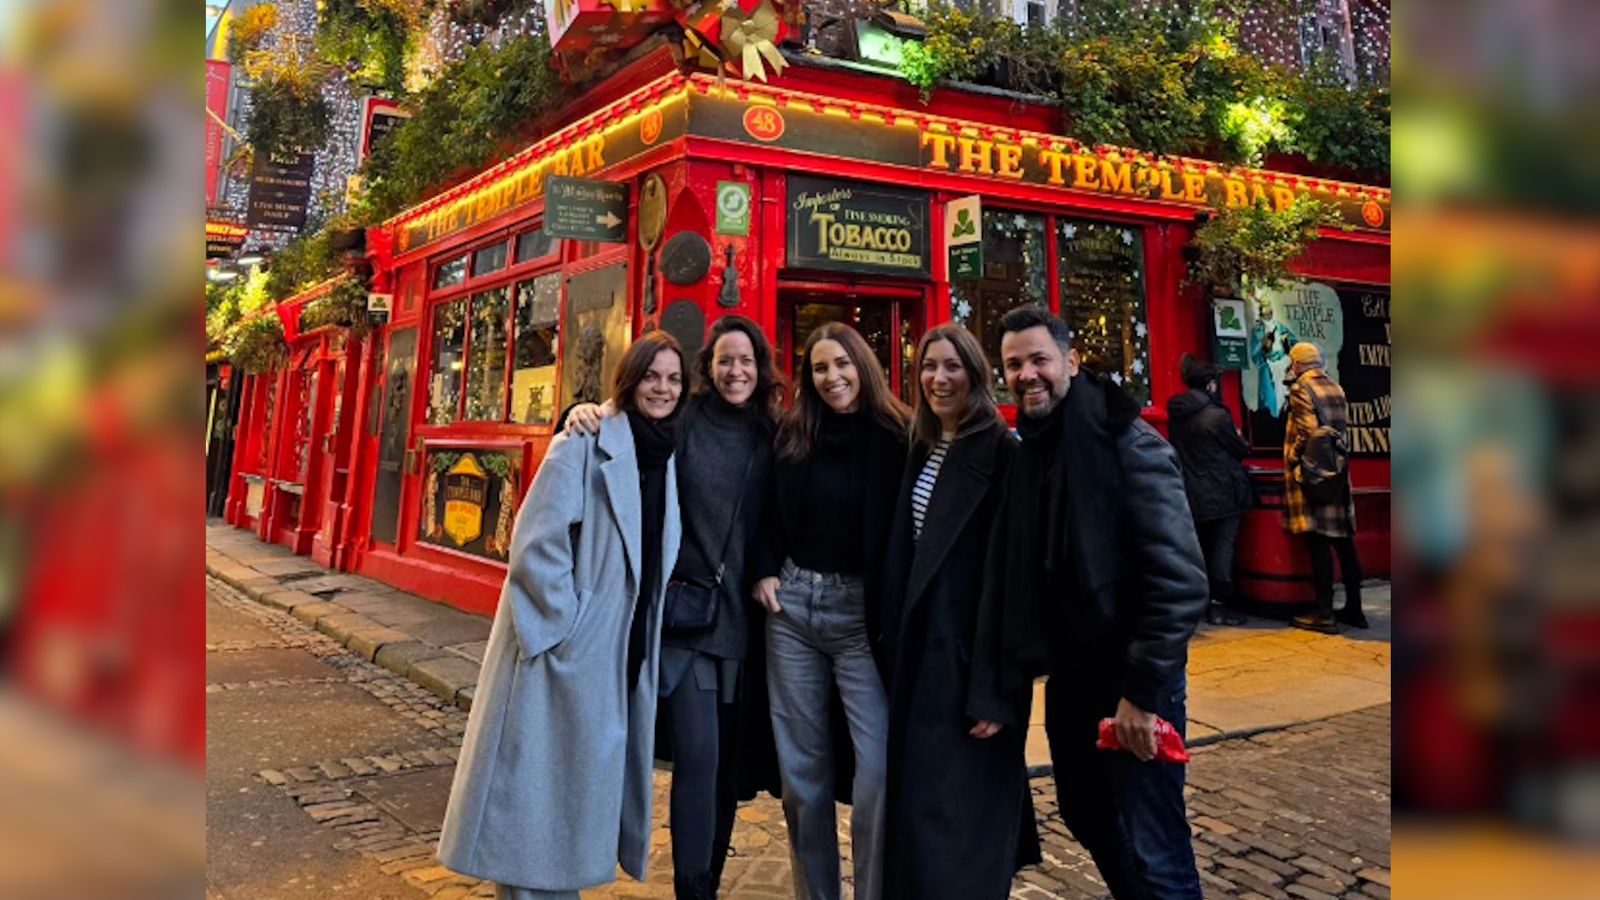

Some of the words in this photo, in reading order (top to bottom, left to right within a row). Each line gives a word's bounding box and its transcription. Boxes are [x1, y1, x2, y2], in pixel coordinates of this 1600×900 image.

[752, 109, 776, 132] 48
[922, 131, 1025, 180] THE
[1039, 149, 1208, 204] TEMPLE
[1224, 178, 1297, 214] BAR
[427, 205, 459, 241] THE
[463, 171, 543, 226] TEMPLE
[553, 133, 605, 177] BAR
[845, 209, 867, 222] FINE
[810, 212, 911, 254] TOBACCO
[1295, 288, 1322, 306] THE
[1284, 304, 1336, 324] TEMPLE
[1299, 321, 1326, 340] BAR
